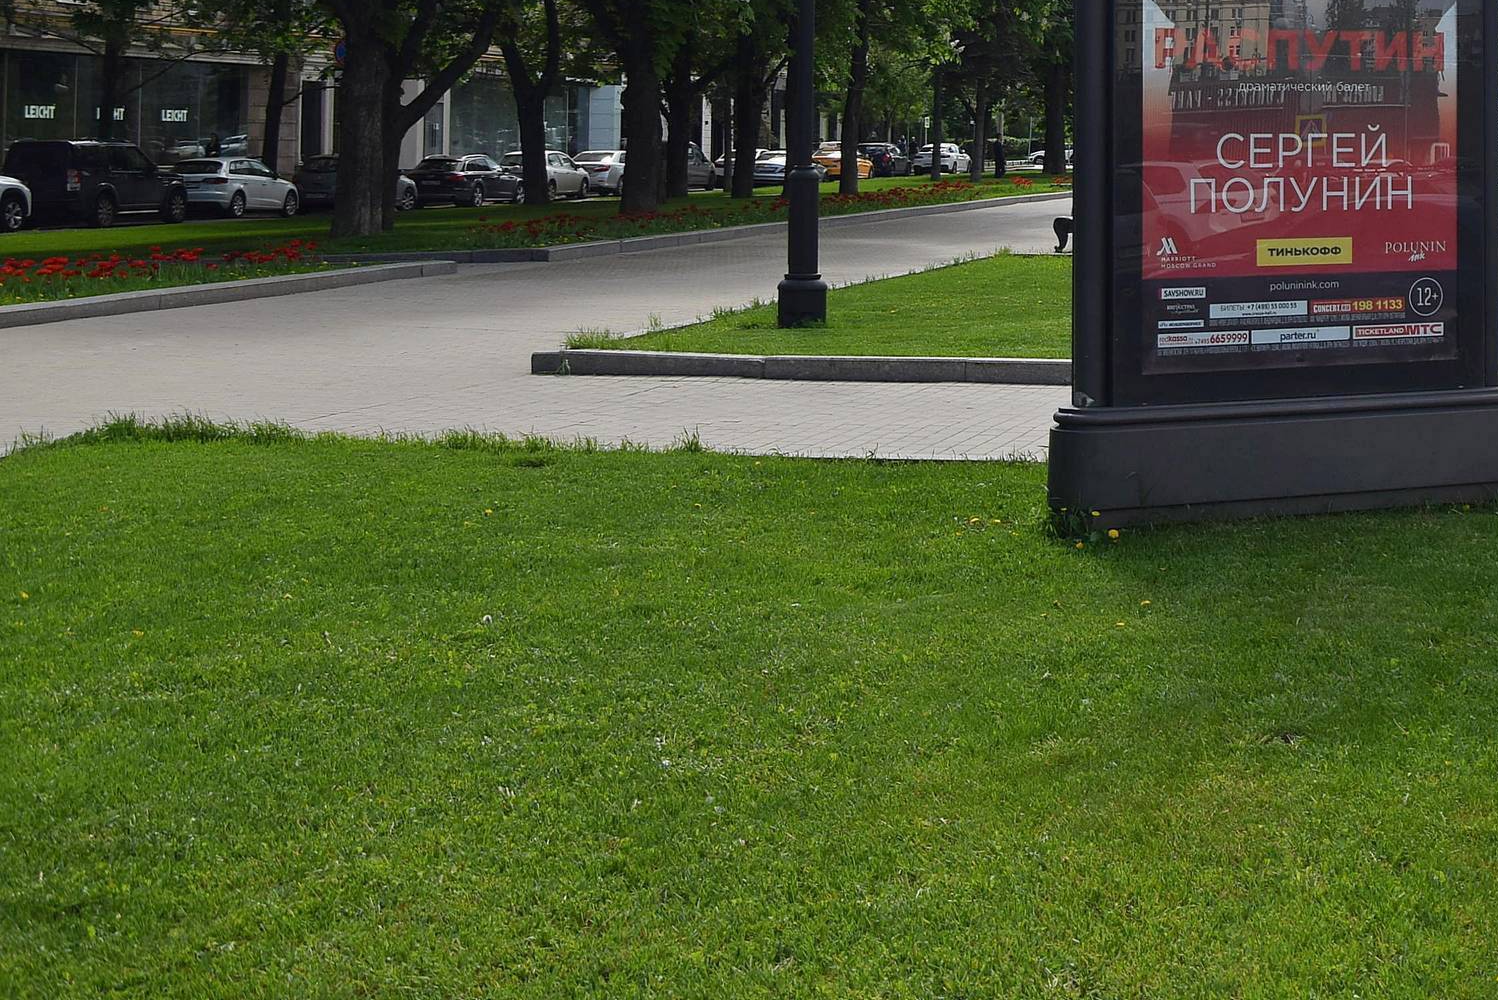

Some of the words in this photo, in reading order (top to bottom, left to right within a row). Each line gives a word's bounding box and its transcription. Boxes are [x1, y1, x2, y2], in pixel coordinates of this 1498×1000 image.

[1155, 27, 1445, 72] РАСПУТИН
[1238, 82, 1332, 93] драматический
[1336, 82, 1370, 92] балет
[25, 105, 56, 119] LEICHT
[161, 109, 189, 122] LEICHT
[1216, 124, 1388, 168] СЕРГЕЙ
[1189, 177, 1413, 213] ПОЛУНИН
[1267, 246, 1342, 257] ТИНЬКОФФ
[1385, 241, 1446, 253] POLUNIN
[1408, 251, 1425, 261] ink
[1417, 287, 1438, 306] 12+
[1352, 301, 1373, 311] 198
[1376, 299, 1402, 310] 1133
[1210, 333, 1248, 344] 6659999
[1280, 331, 1316, 341] parter.ru
